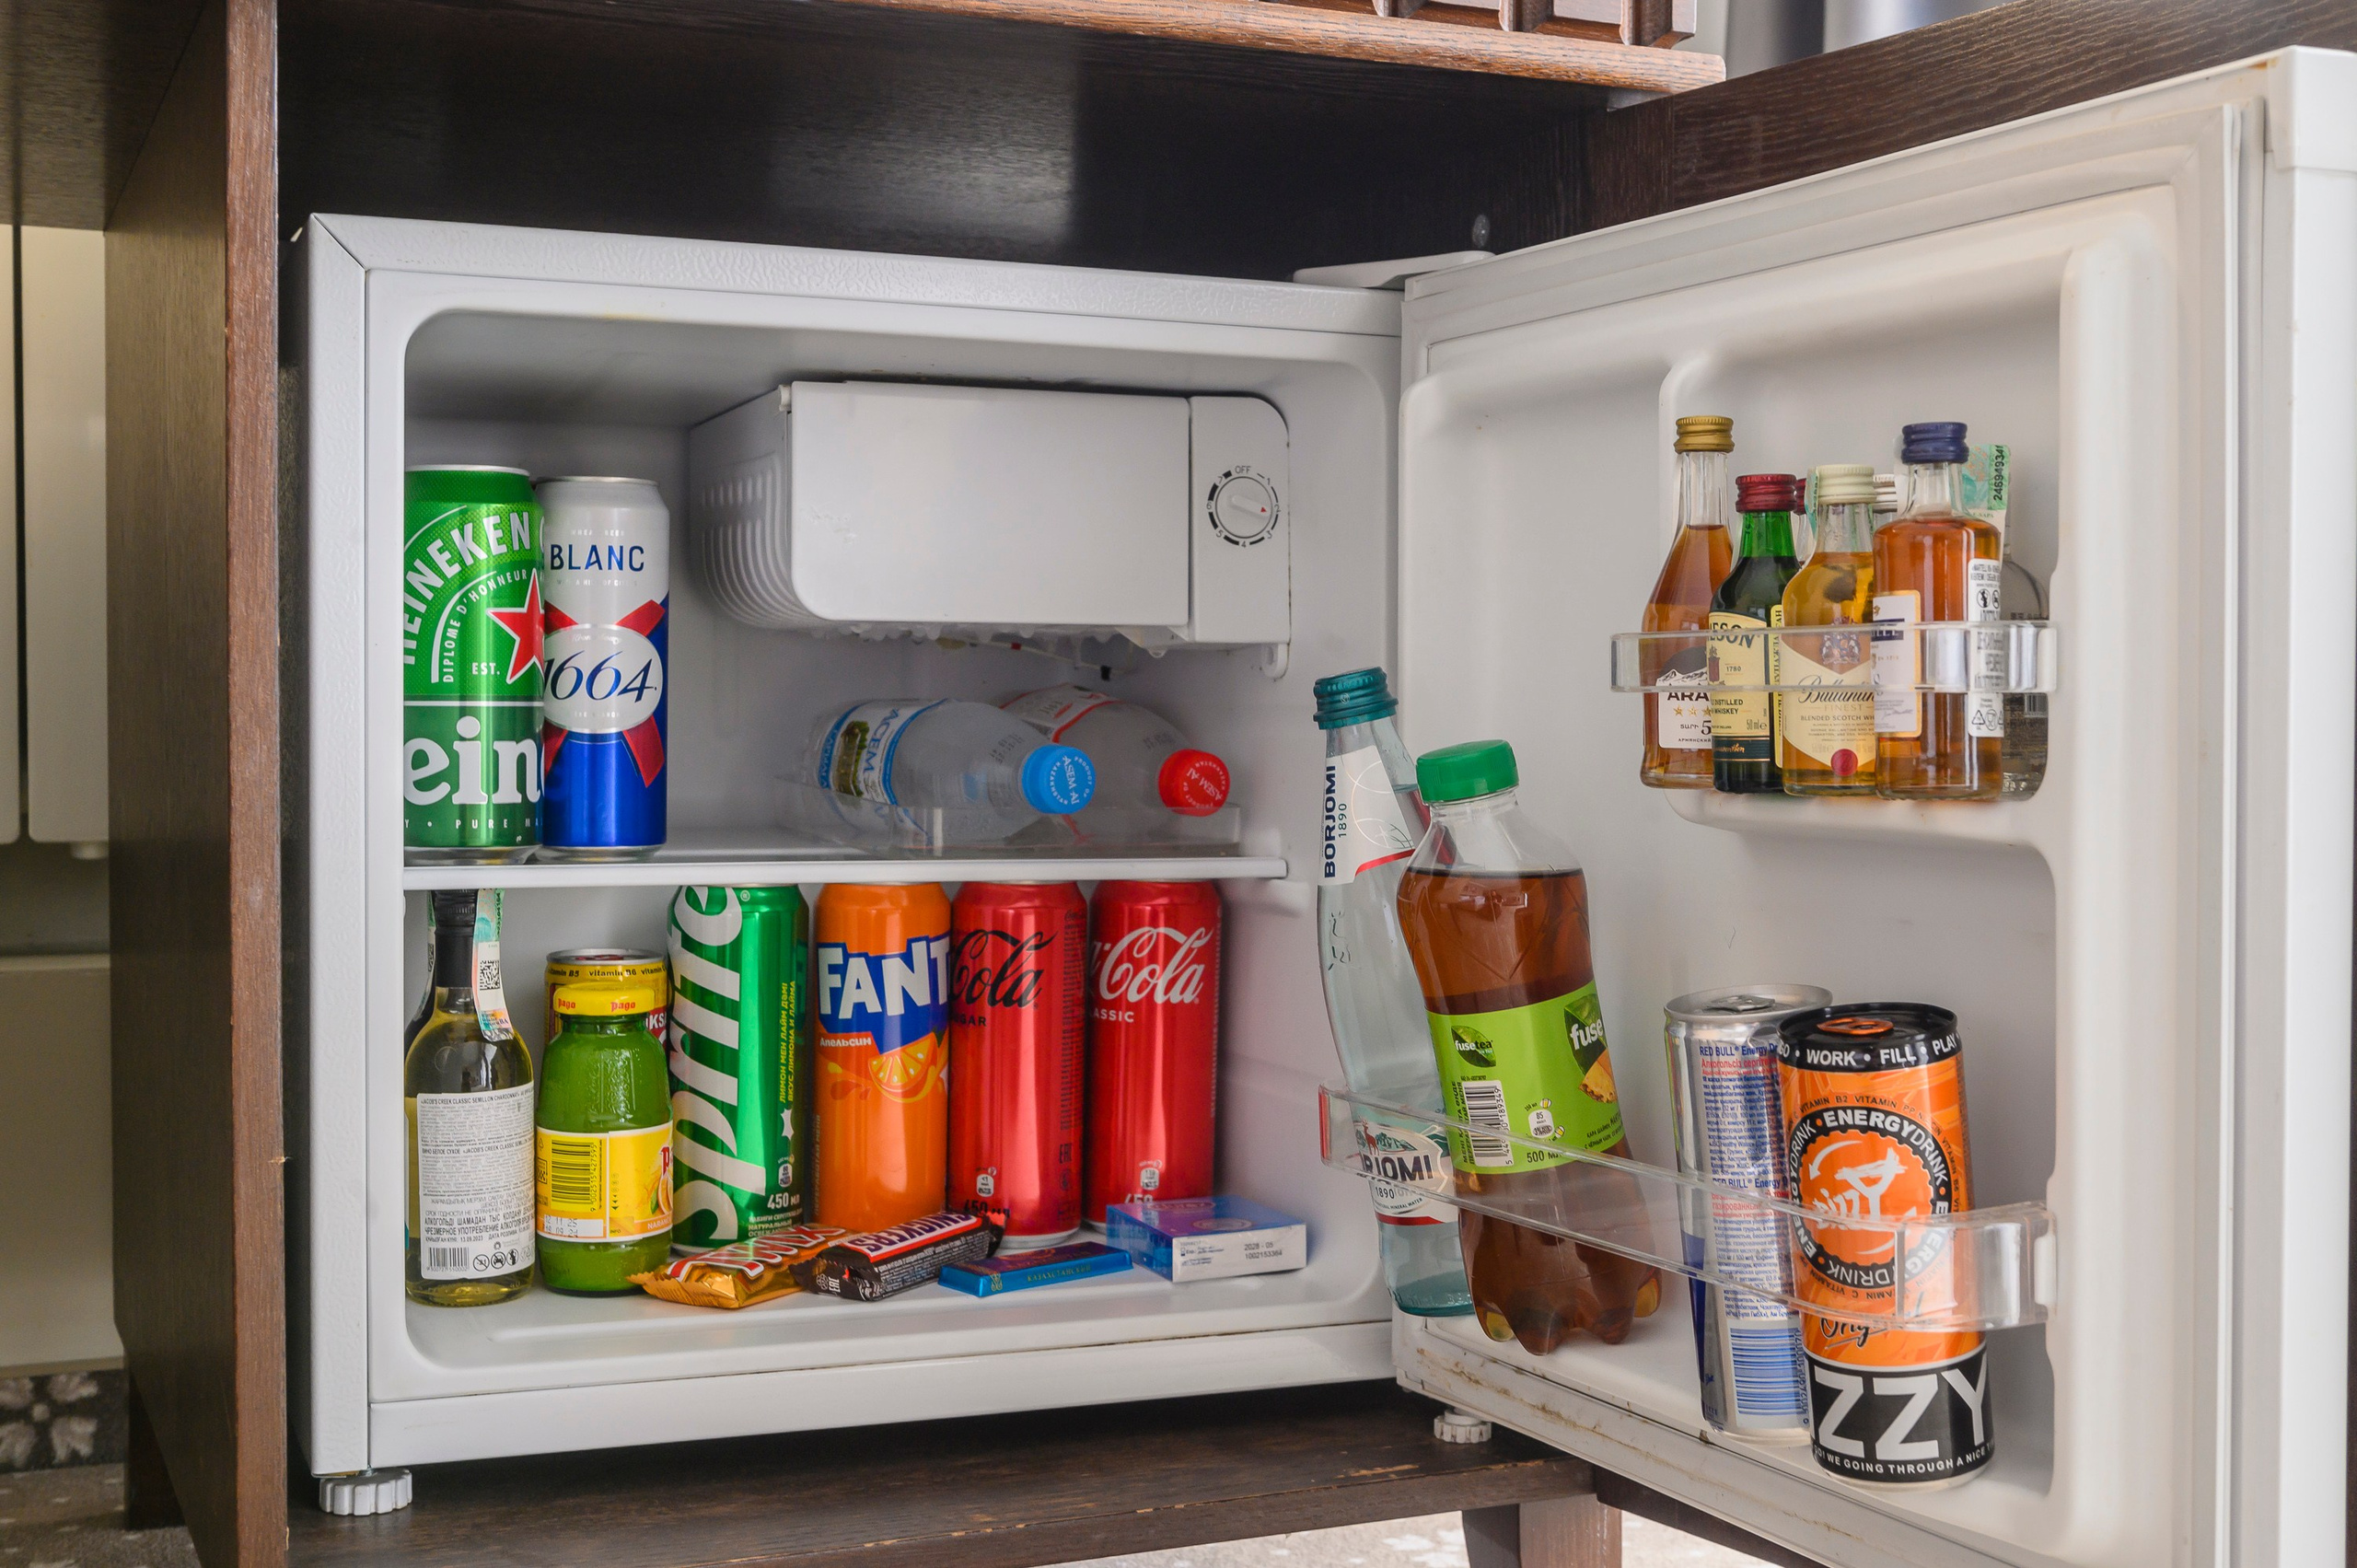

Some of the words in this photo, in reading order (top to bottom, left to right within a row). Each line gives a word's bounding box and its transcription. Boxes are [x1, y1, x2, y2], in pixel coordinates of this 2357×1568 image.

[1235, 465, 1251, 474] OFF
[1218, 475, 1224, 484] 7
[1216, 529, 1224, 538] 5
[1266, 530, 1272, 539] 3
[550, 544, 644, 572] BLANC
[443, 619, 461, 682] DIPLOME
[457, 569, 527, 615] D'HONNEUR
[1710, 622, 1757, 648] ESON
[471, 662, 500, 675] EST.
[1701, 720, 1712, 735] 5
[403, 715, 545, 806] ein
[1062, 755, 1077, 789] ASEM
[1070, 791, 1080, 805] AI
[1199, 777, 1223, 800] ASEM
[456, 819, 507, 829] PURE
[1324, 766, 1336, 877] BORJOMI
[1339, 803, 1347, 838] 1890
[949, 929, 1059, 1007] Cola
[558, 998, 575, 1010] pago
[610, 1001, 635, 1012] pago
[1093, 1007, 1134, 1023] ASSIC
[820, 1037, 872, 1047] Апельсин
[1455, 1040, 1492, 1051] fusetea
[1700, 1046, 1713, 1056] RED
[1741, 1045, 1768, 1056] Energy
[1806, 1049, 1857, 1066] WORK
[1879, 1046, 1917, 1064] FILL
[1932, 1033, 1956, 1056] PLAY
[1799, 1096, 1830, 1112] VITAMIN
[1854, 1096, 1898, 1109] VITAMIN
[1823, 1109, 1949, 1186] ENERGYDRINK
[1527, 1150, 1545, 1163] 500
[1754, 1179, 1781, 1189] Energy
[1376, 1186, 1395, 1199] 1890
[767, 1192, 789, 1209] 450
[1408, 1198, 1422, 1207] WATER
[457, 1216, 486, 1225] ШАМАДАН
[489, 1214, 500, 1223] ТЫС
[424, 1226, 457, 1236] ЧРЕЗМЕРНОЕ
[458, 1224, 499, 1236] УПОТРЕБЛЕНИЕ
[488, 1232, 500, 1240] ДАТА
[667, 1225, 846, 1283] TWIX
[1808, 1353, 1988, 1461] ZZY
[1827, 1453, 1841, 1466] WE
[1843, 1459, 1885, 1473] GOING
[1887, 1460, 1954, 1474] THROUGH
[1956, 1458, 1964, 1467] A
[1966, 1449, 1986, 1463] NICE
